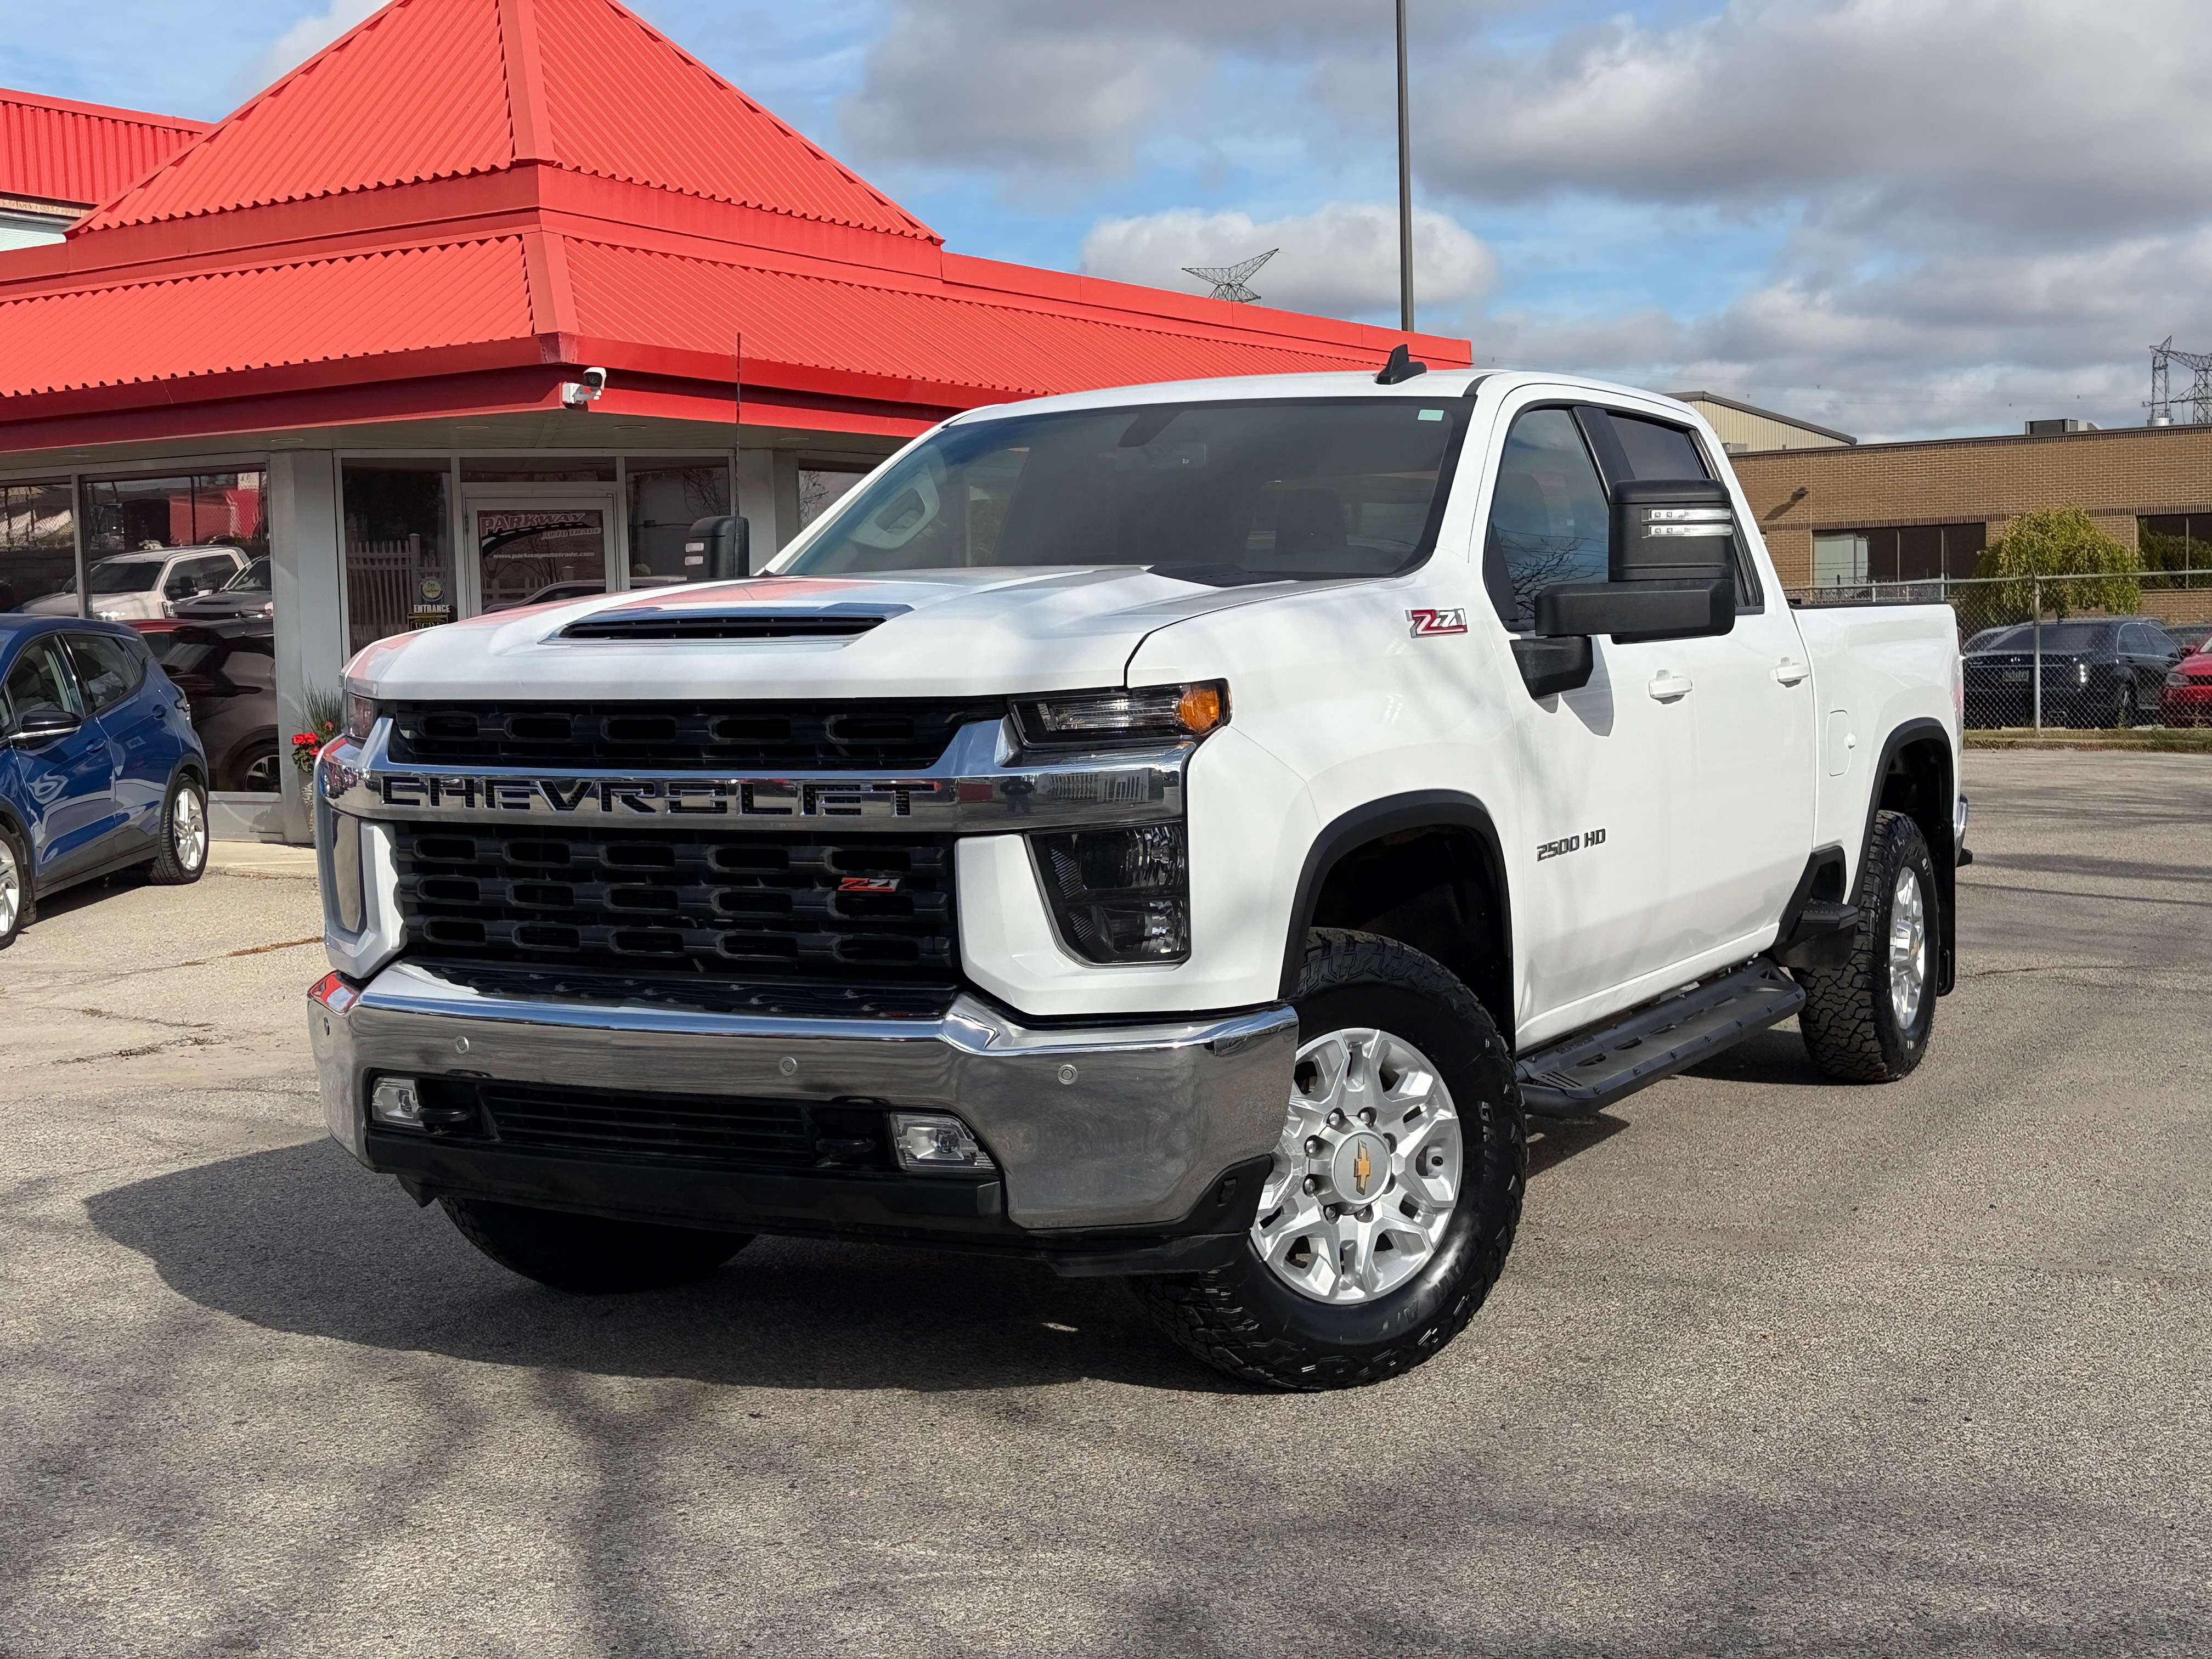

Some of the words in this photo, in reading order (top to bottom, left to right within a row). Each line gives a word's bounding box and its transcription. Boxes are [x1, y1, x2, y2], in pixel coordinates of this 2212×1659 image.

[479, 513, 585, 536] PARKWAY
[413, 605, 450, 613] ENTRANCE
[1405, 608, 1468, 638] Z71
[382, 776, 940, 817] CHEVROLET
[1537, 835, 1579, 862] 2500
[1584, 828, 1606, 848] HD
[838, 878, 900, 892] Z71
